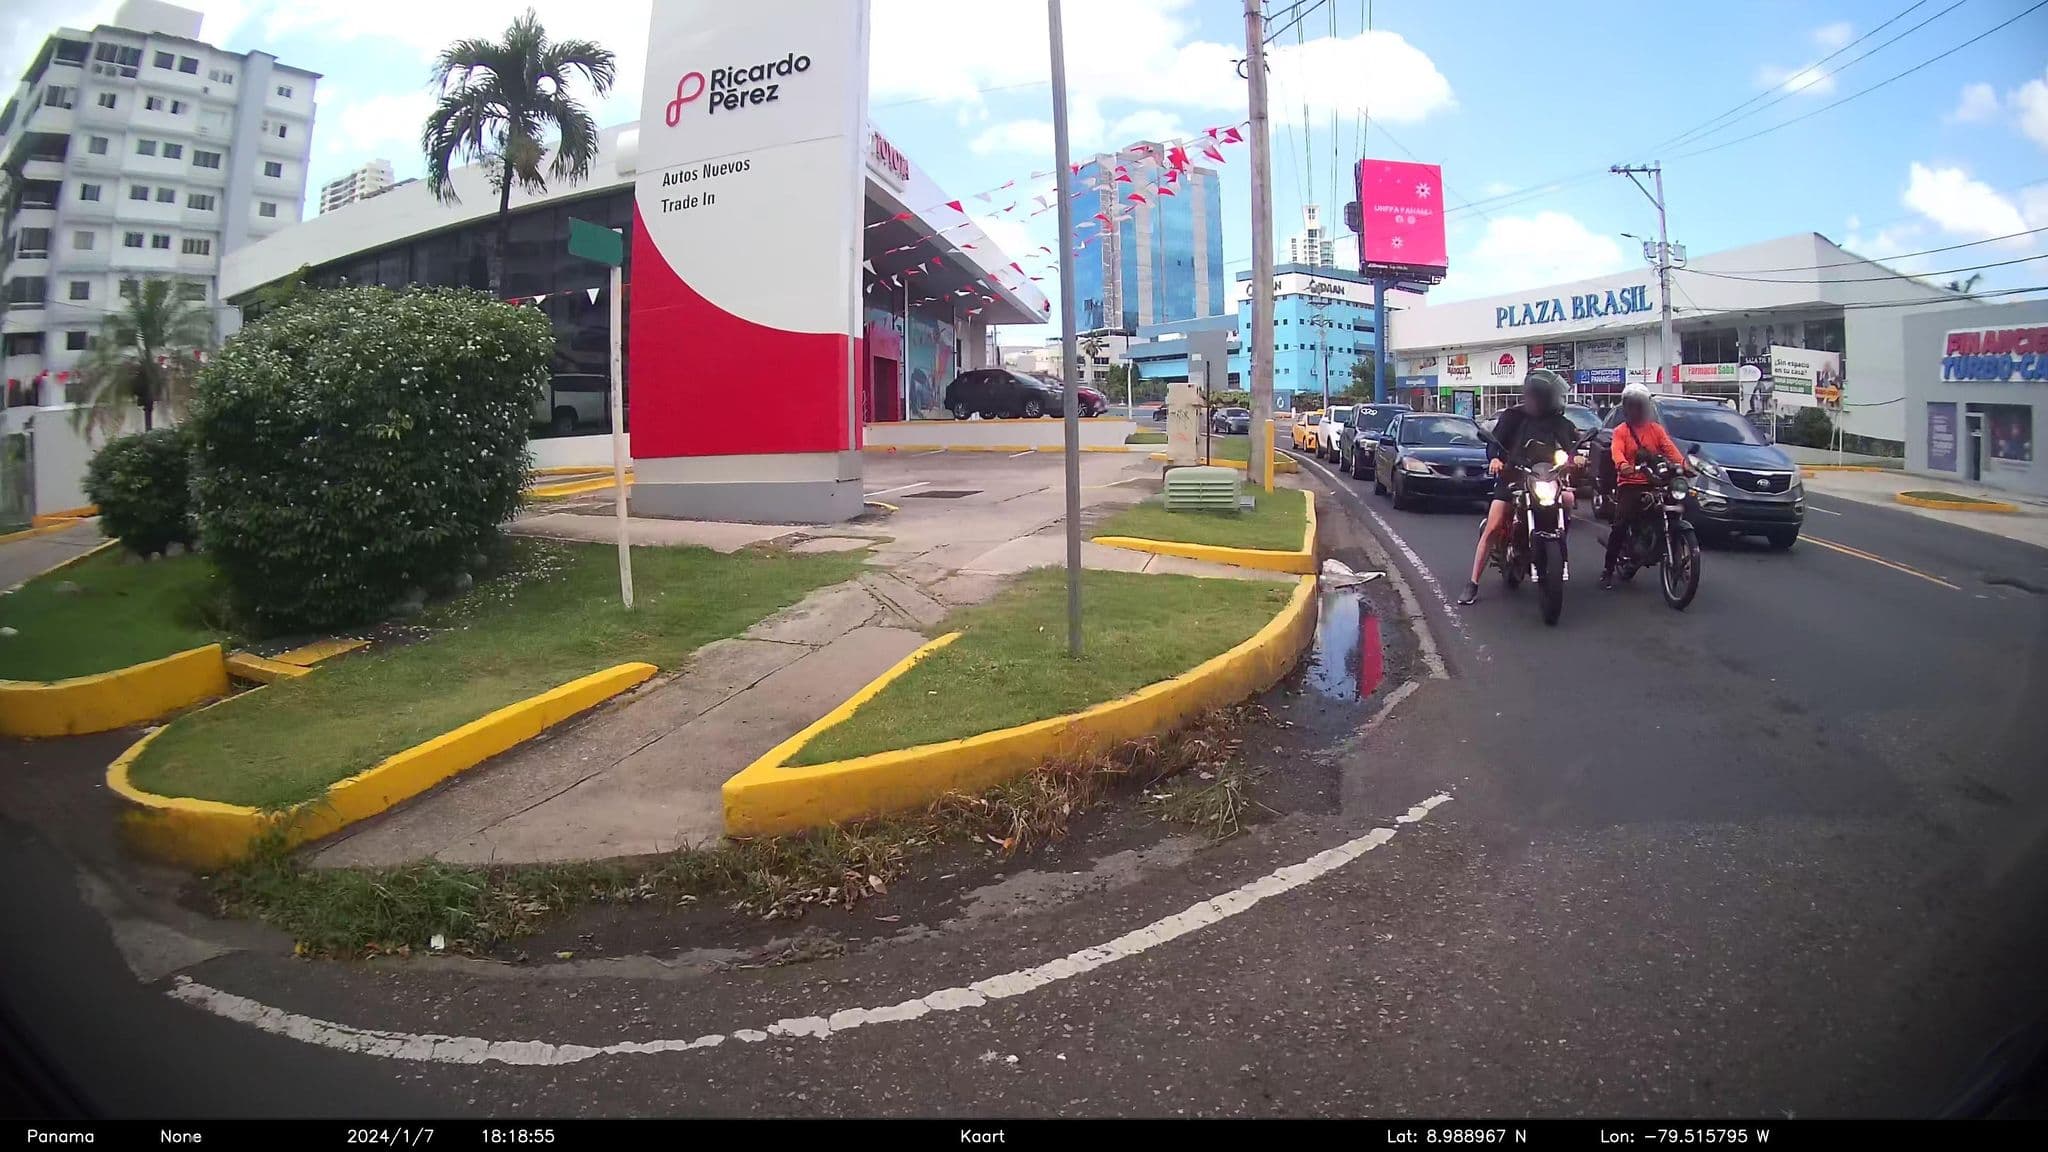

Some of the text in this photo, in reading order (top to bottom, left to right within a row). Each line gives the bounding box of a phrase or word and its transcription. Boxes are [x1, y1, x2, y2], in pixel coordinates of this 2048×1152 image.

[709, 52, 811, 91] Ricardo
[662, 159, 750, 187] Autos Nuevos
[874, 131, 909, 181] TOYOTA
[661, 191, 715, 213] Trade In
[1495, 285, 1653, 329] PLAZA BRASIL
